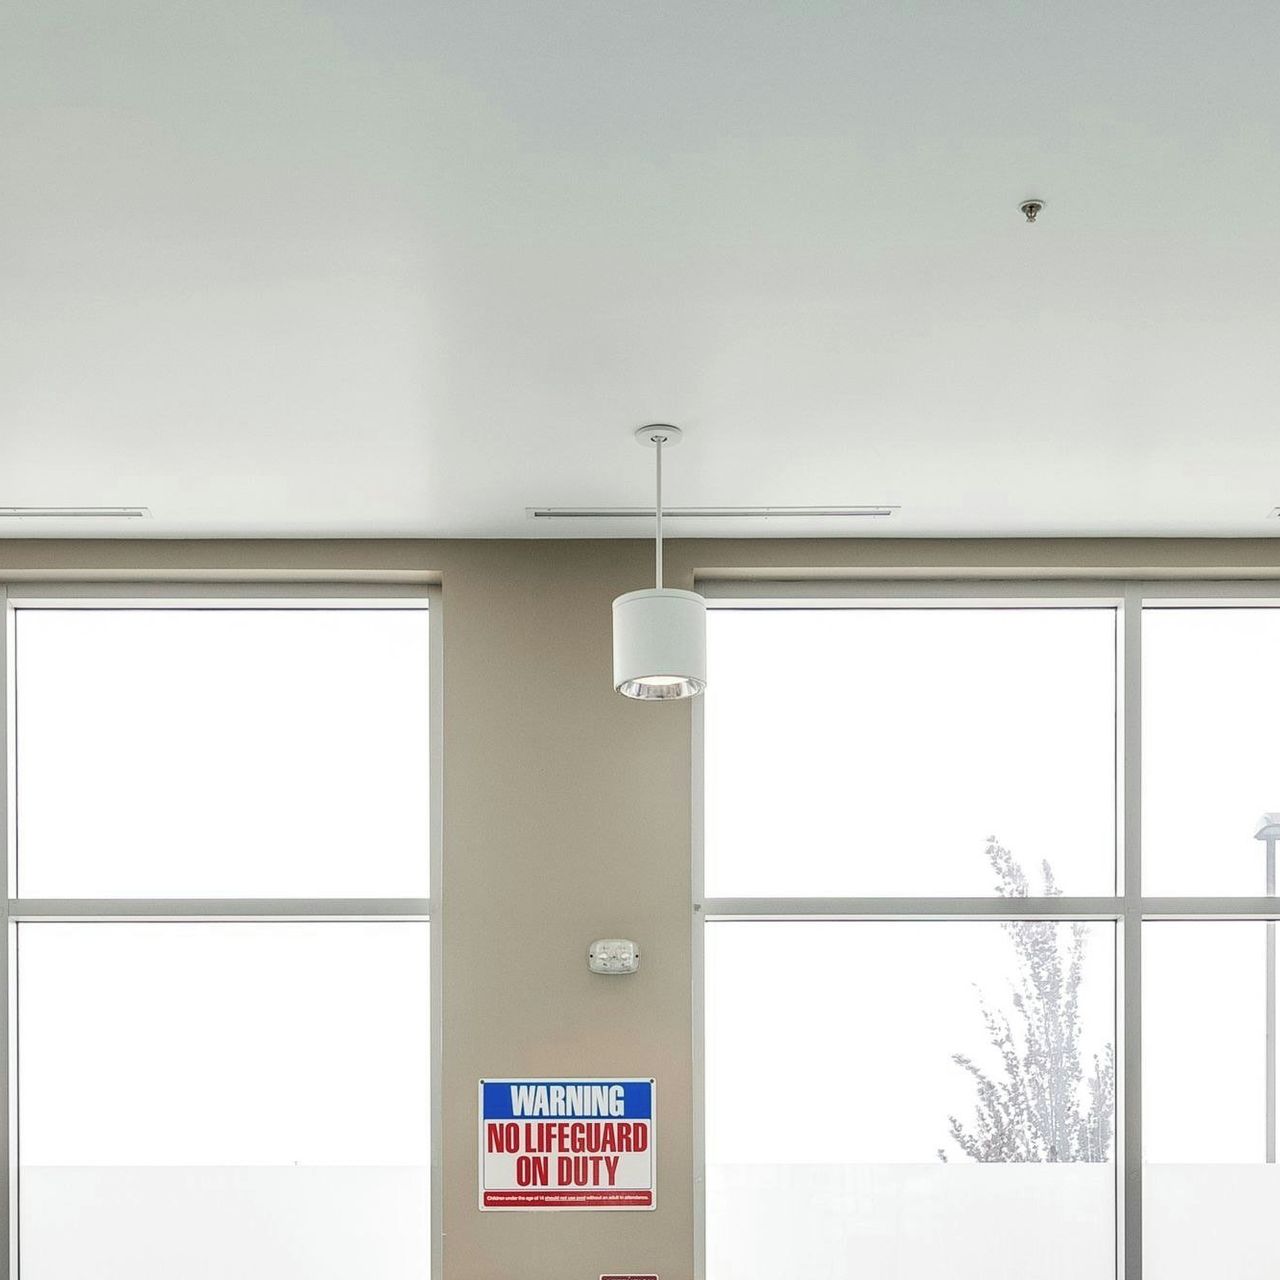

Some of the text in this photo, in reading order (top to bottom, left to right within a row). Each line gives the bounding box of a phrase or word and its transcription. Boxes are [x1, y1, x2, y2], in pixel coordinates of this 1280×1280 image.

[510, 1084, 625, 1117] WARNING
[487, 1122, 648, 1154] NO LIFEGUARD
[516, 1155, 620, 1187] ON DUTY
